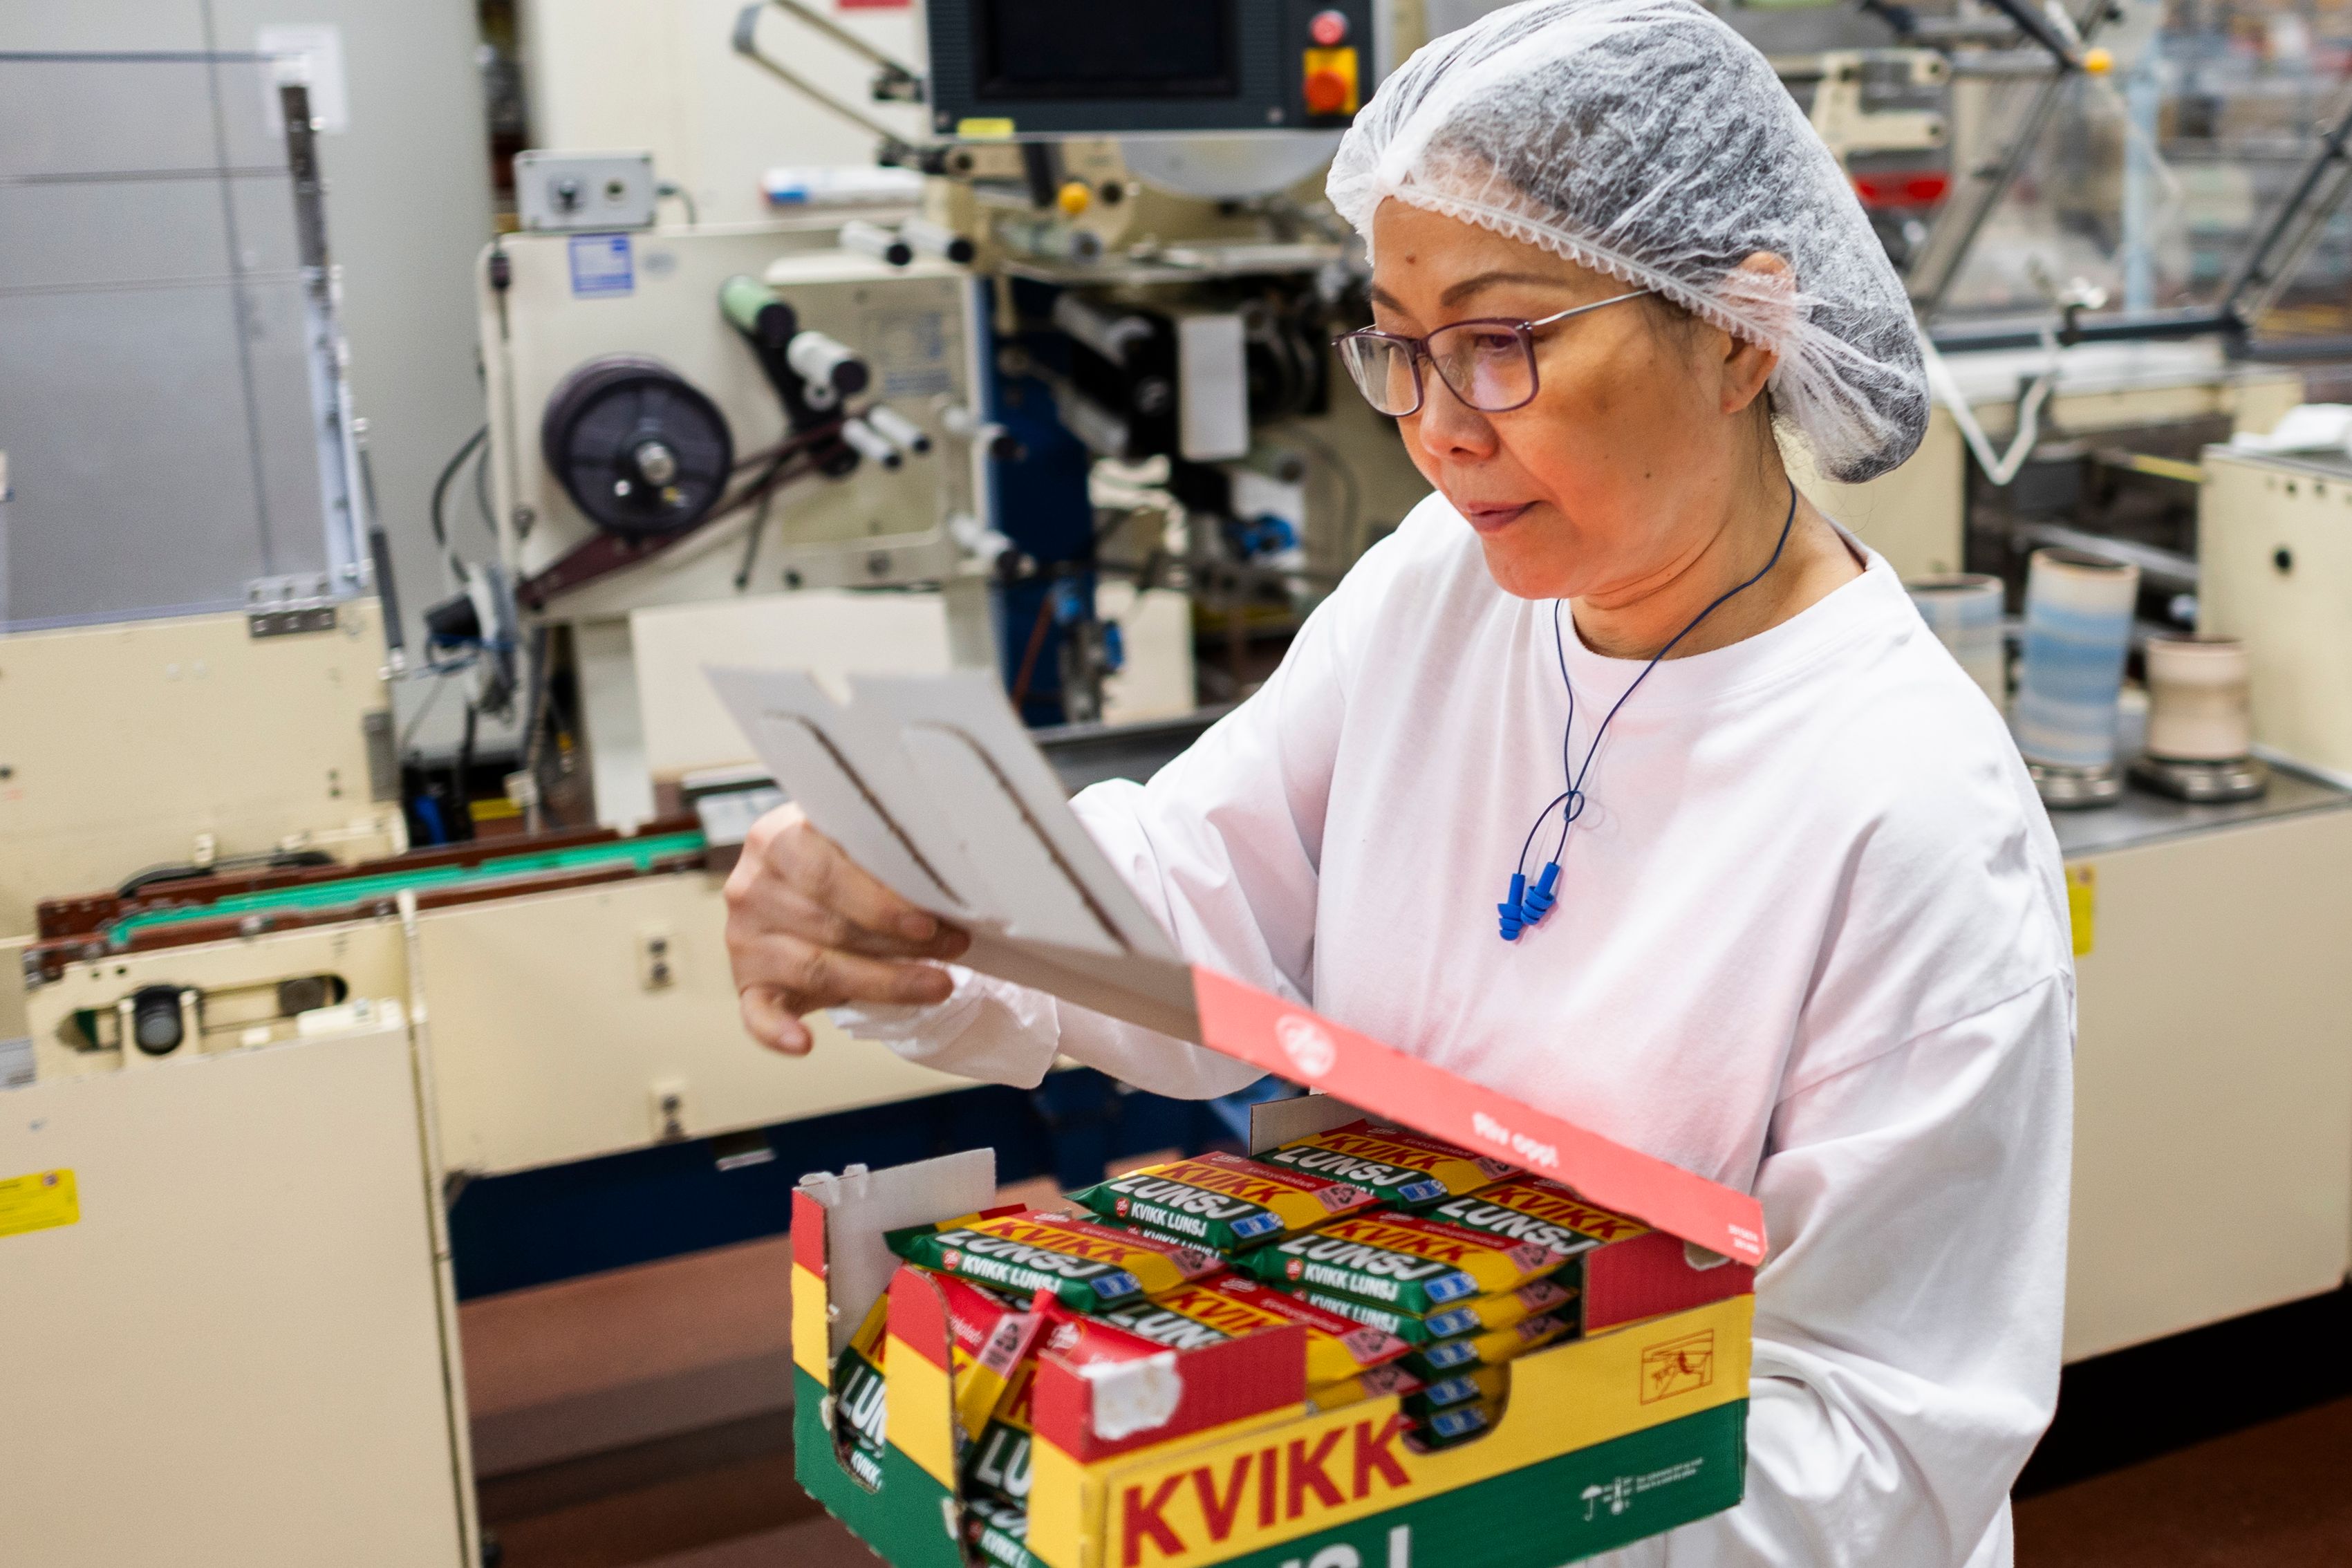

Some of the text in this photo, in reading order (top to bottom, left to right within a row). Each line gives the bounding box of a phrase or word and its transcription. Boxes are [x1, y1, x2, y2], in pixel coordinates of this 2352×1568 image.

[1273, 1147, 1419, 1186] LUNSJ
[1315, 1135, 1457, 1170] KVIKK
[1109, 1175, 1256, 1219] LUNSJ
[1161, 1164, 1298, 1204] KVIKK
[1131, 1202, 1168, 1226] KVIKK
[1167, 1212, 1208, 1238] LUNSJ
[1437, 1197, 1601, 1255] LUNSJ
[1483, 1186, 1634, 1240] KVIKK
[935, 1230, 1114, 1278] LUNSJ
[982, 1221, 1146, 1264] KVIKK
[1278, 1234, 1450, 1281] LUNSJ
[1319, 1223, 1488, 1263] KVIKK
[962, 1253, 1010, 1282] KVIKK
[1304, 1262, 1350, 1289] KVIKK
[1350, 1273, 1400, 1302] LUNSJ
[1121, 1412, 1412, 1568] KVIKK
